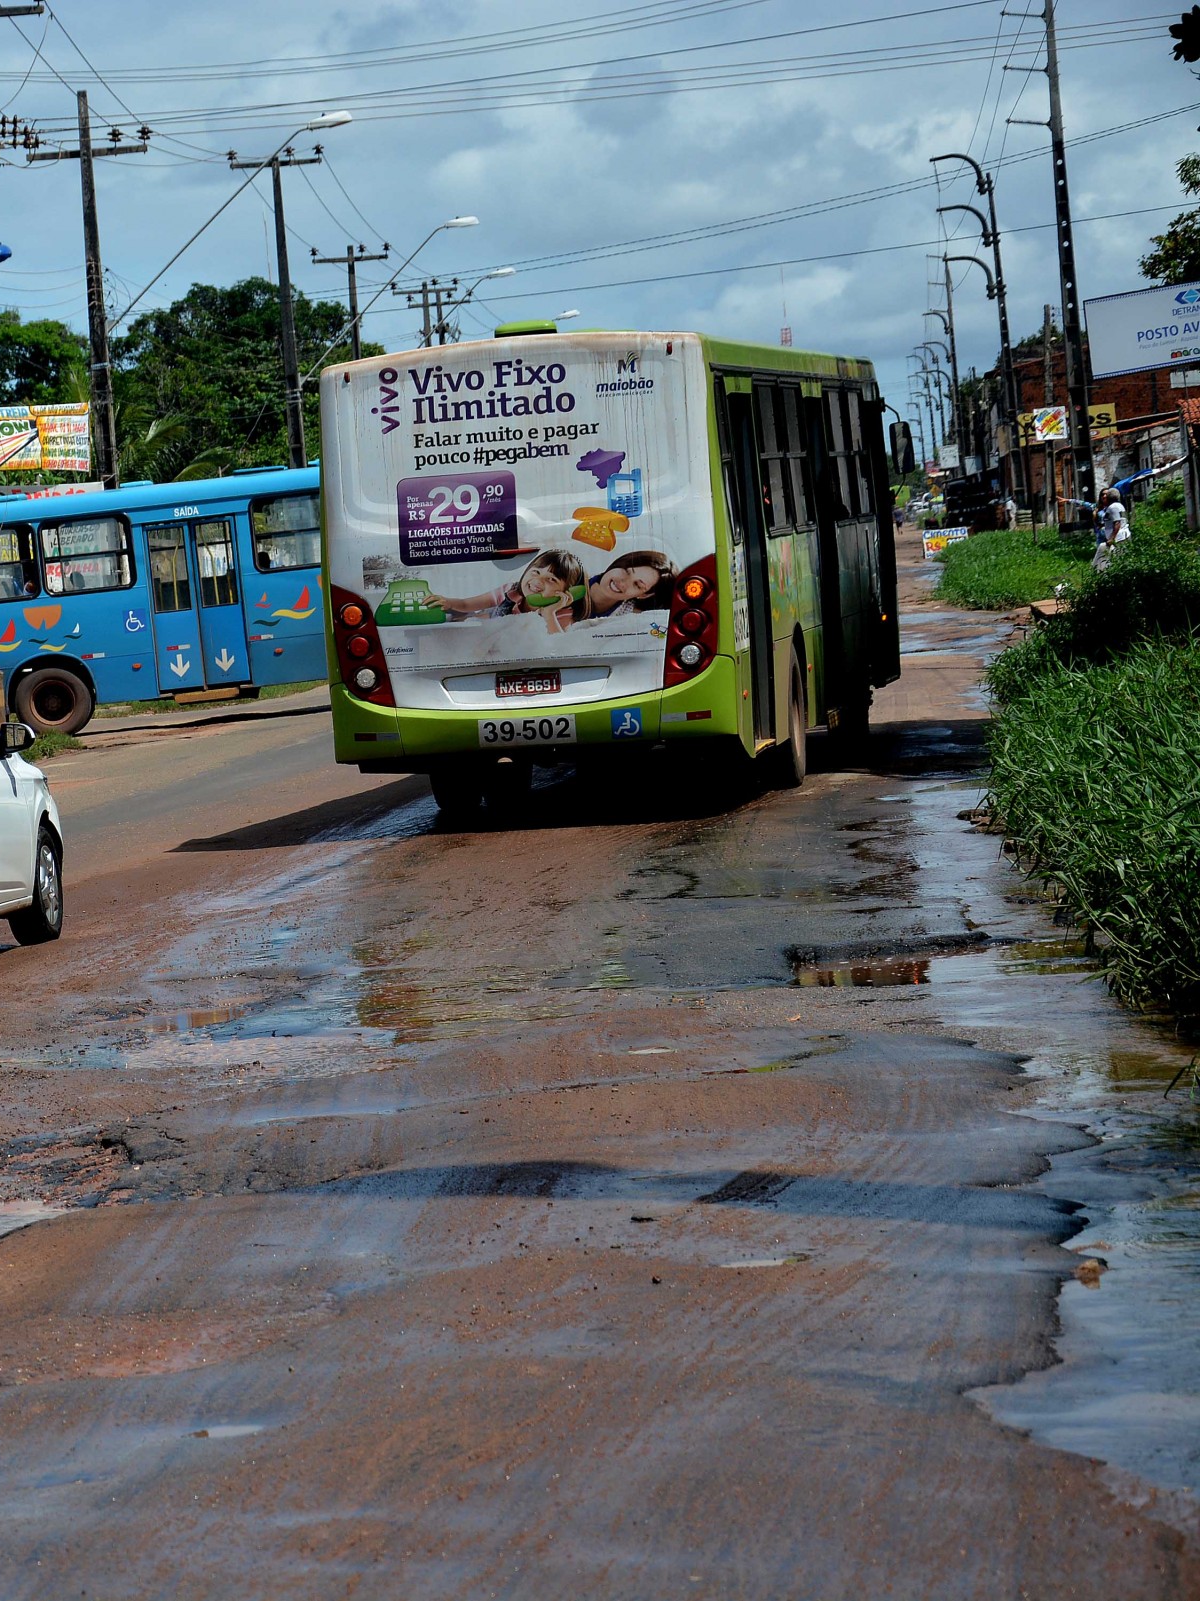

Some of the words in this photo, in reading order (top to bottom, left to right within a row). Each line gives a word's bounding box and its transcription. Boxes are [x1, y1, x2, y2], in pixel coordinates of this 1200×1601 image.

[1137, 325, 1179, 342] POSTO
[408, 366, 484, 395] Vivo
[493, 359, 566, 388] Fixo
[596, 377, 654, 392] maiobão
[371, 367, 400, 435] vivo
[413, 387, 575, 424] Ilimitado
[413, 431, 461, 448] Falar
[466, 425, 523, 444] muito
[528, 428, 539, 439] e
[543, 421, 600, 441] pagar
[414, 450, 470, 470] pouco
[473, 441, 570, 466] #pegabem
[173, 505, 199, 517] SAÍDA
[407, 501, 433, 509] apenas
[408, 509, 426, 521] R$
[408, 526, 451, 538] LIGAÇÕES
[453, 523, 505, 535] ILIMITADAS
[53, 534, 94, 546] LBERADO
[409, 540, 427, 550] para
[428, 537, 466, 547] celulares
[467, 535, 486, 544] Vivo
[409, 549, 430, 558] fixos
[430, 548, 442, 556] de
[442, 547, 462, 555] todo
[483, 717, 571, 743] 39-502
